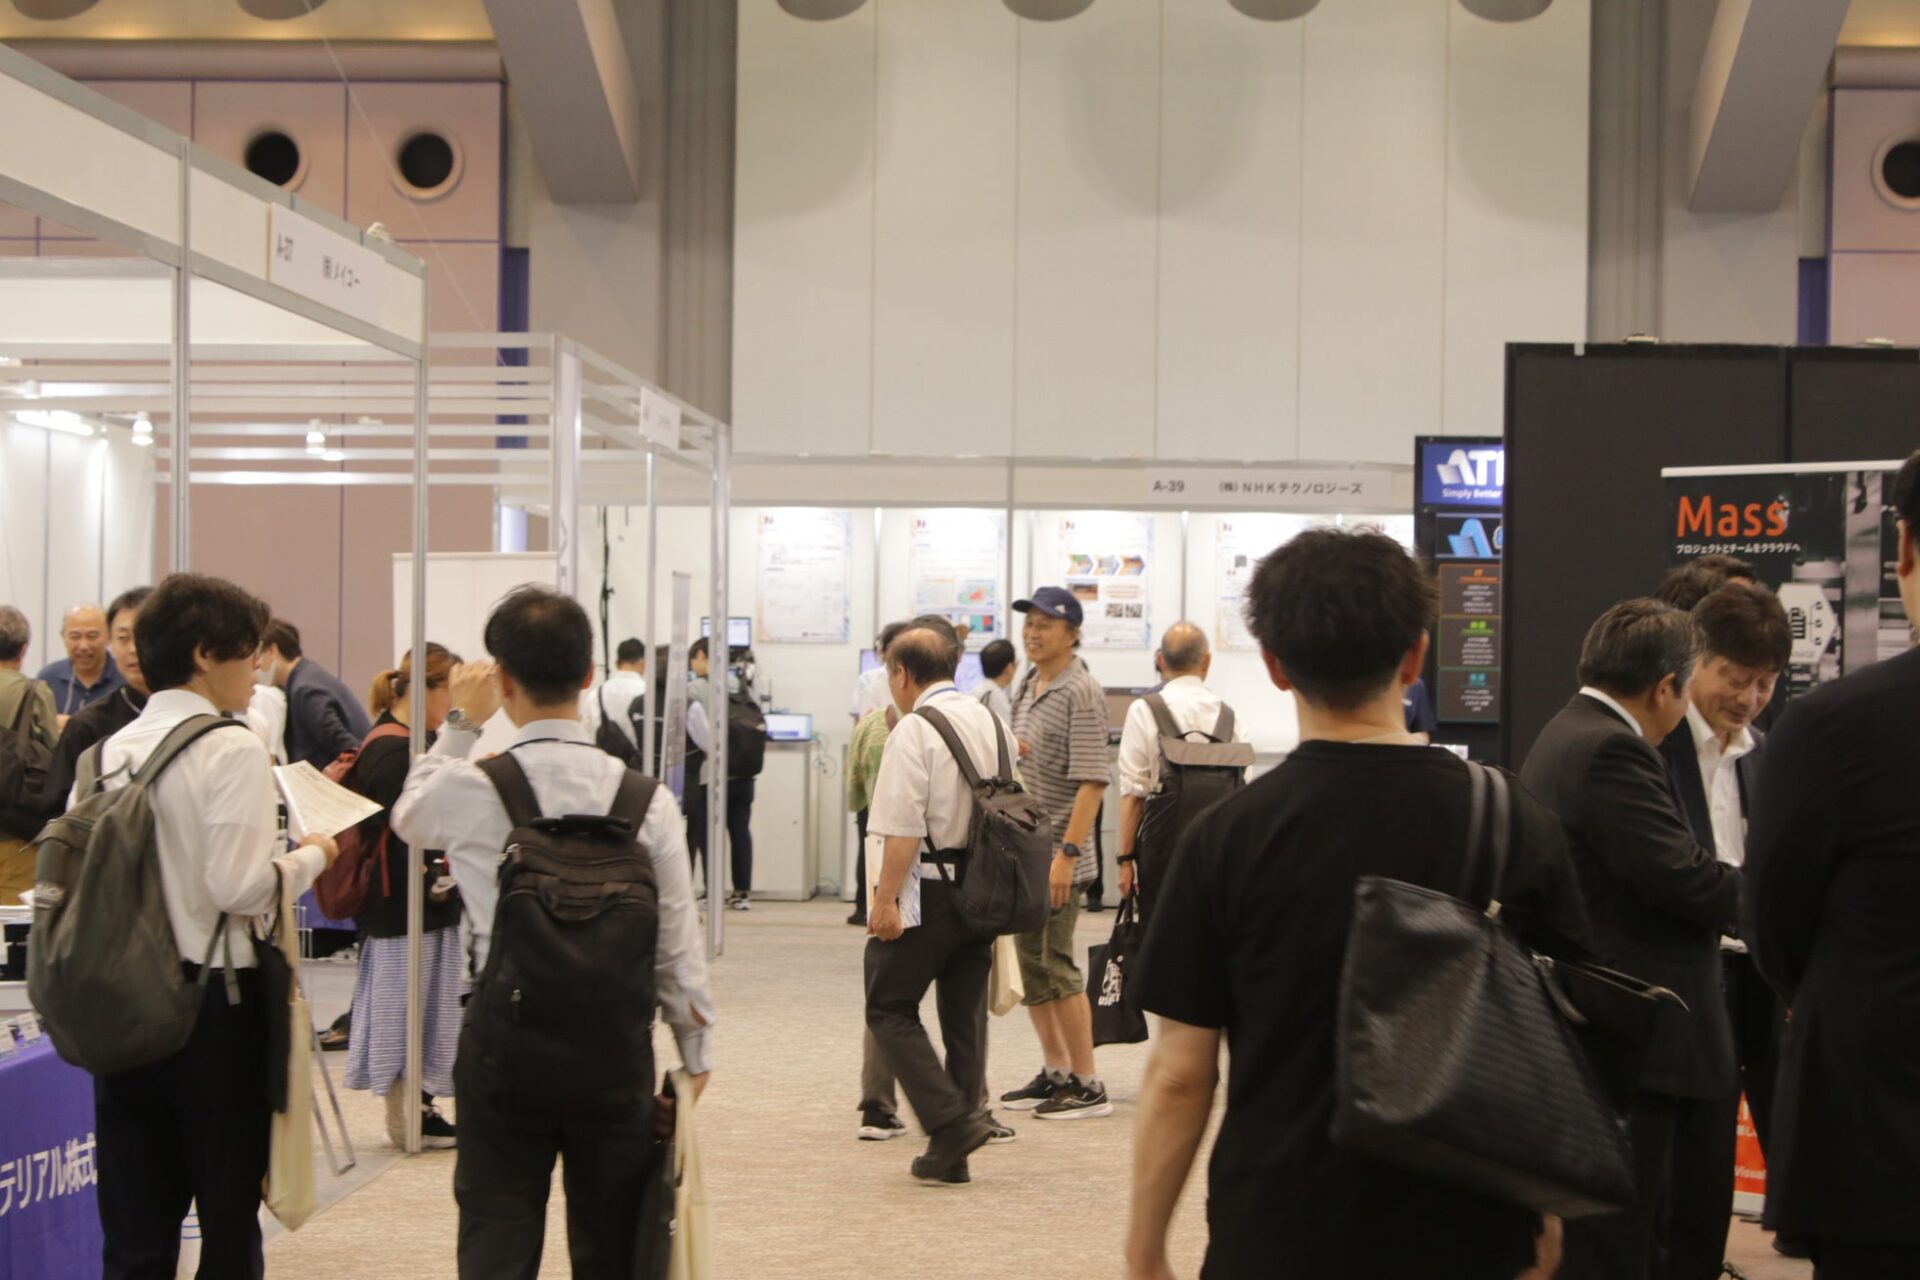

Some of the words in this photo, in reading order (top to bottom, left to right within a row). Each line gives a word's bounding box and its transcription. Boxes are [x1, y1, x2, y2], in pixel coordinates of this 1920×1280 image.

[1152, 480, 1185, 493] A-39
[1677, 495, 1789, 538] Mass
[1676, 542, 1800, 555] プロジェクトとチームをクラウドへ
